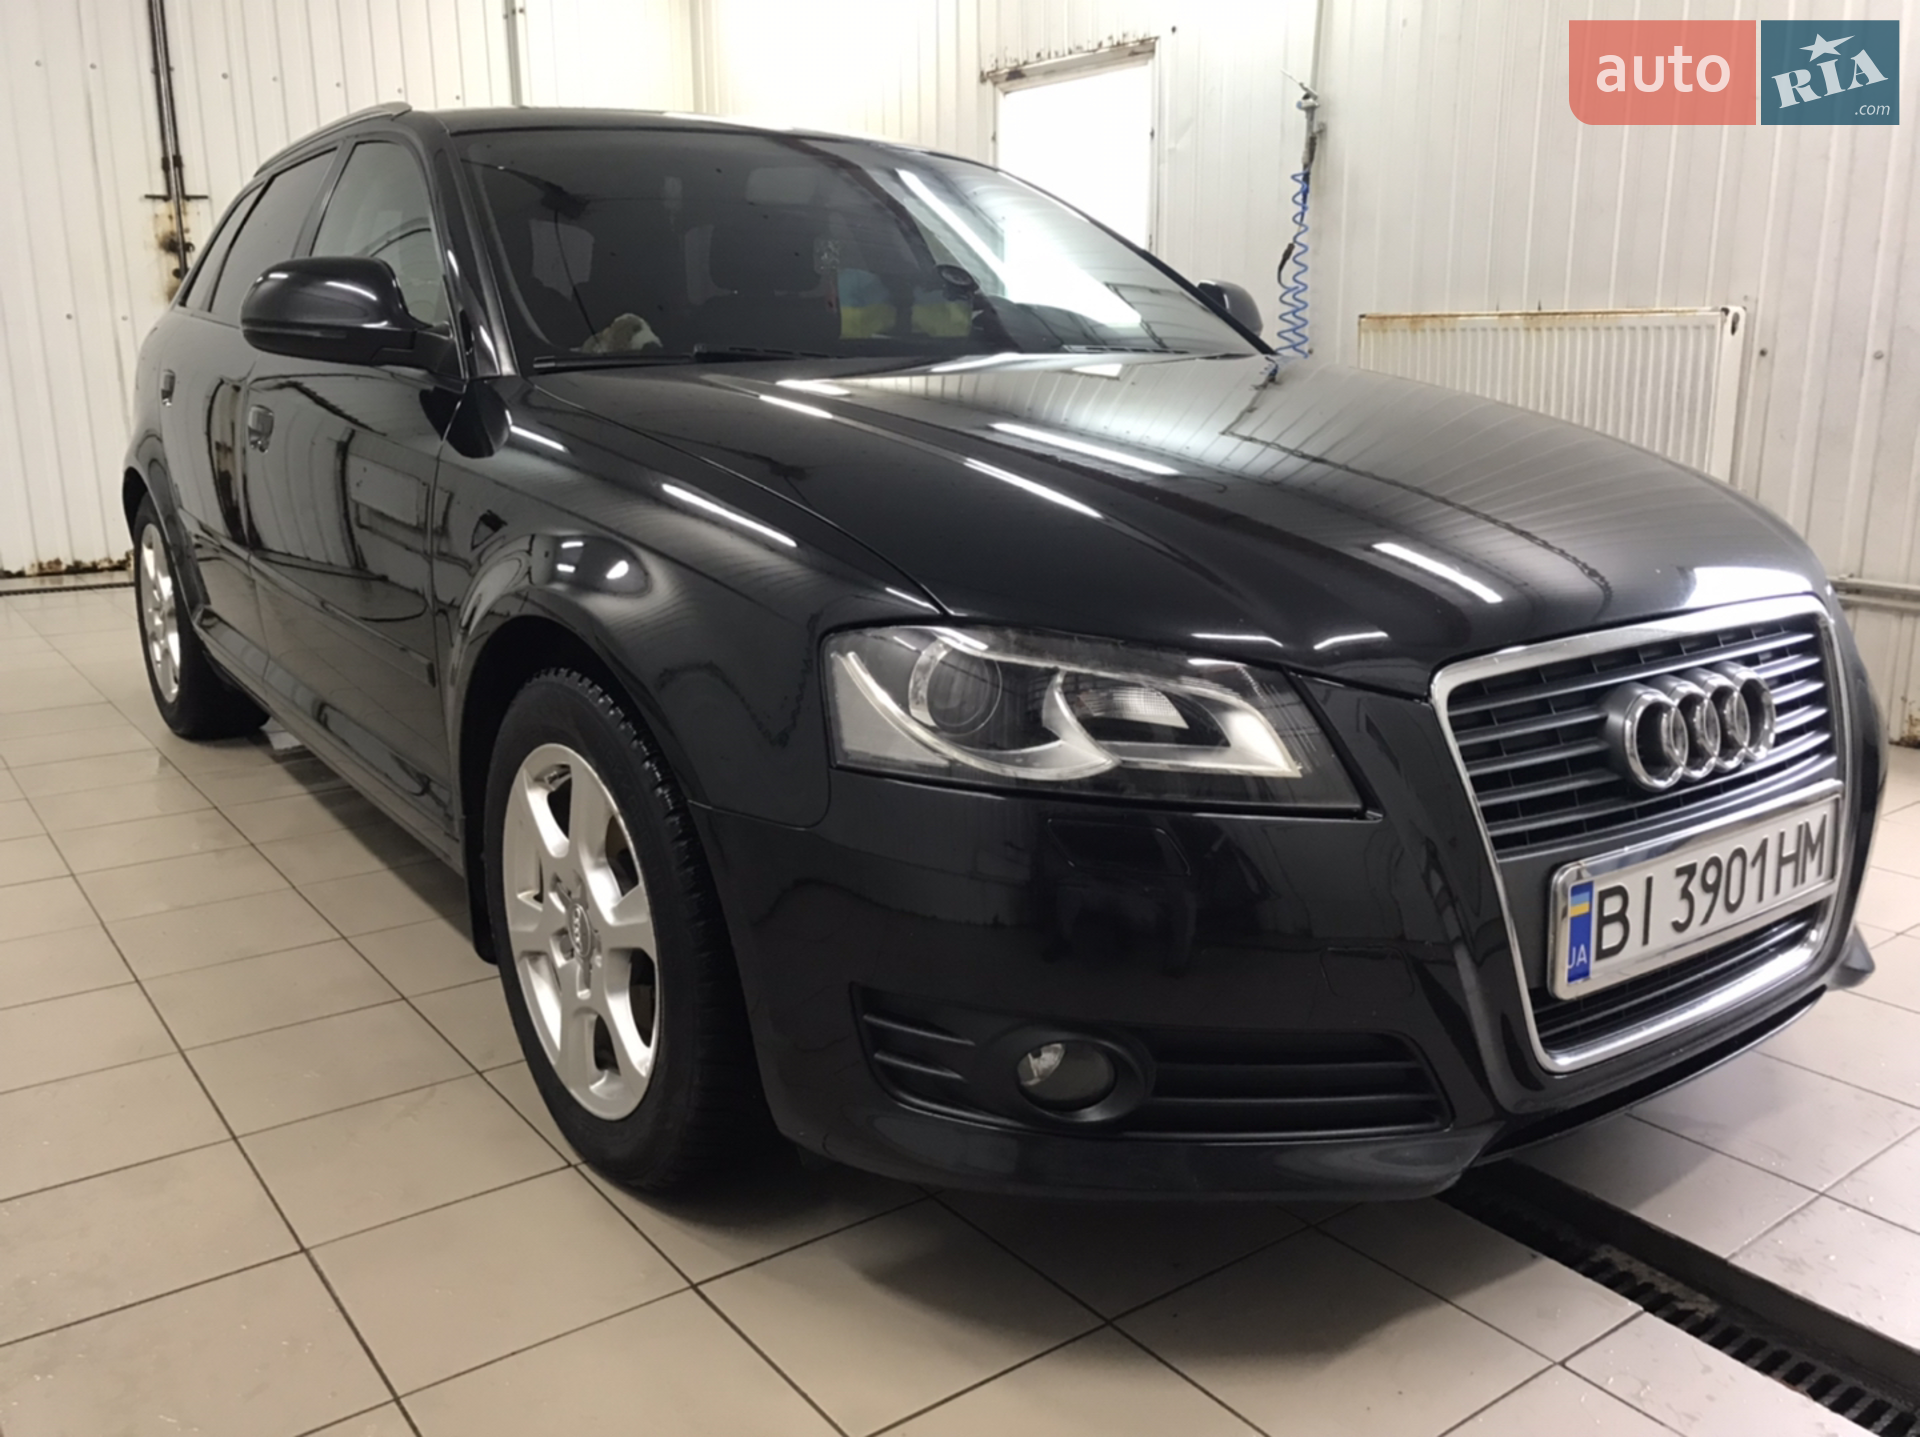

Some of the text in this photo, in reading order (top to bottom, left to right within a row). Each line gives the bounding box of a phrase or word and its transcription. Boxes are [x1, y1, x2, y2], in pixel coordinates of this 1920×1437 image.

[1596, 813, 1828, 962] BI 3901 HM
